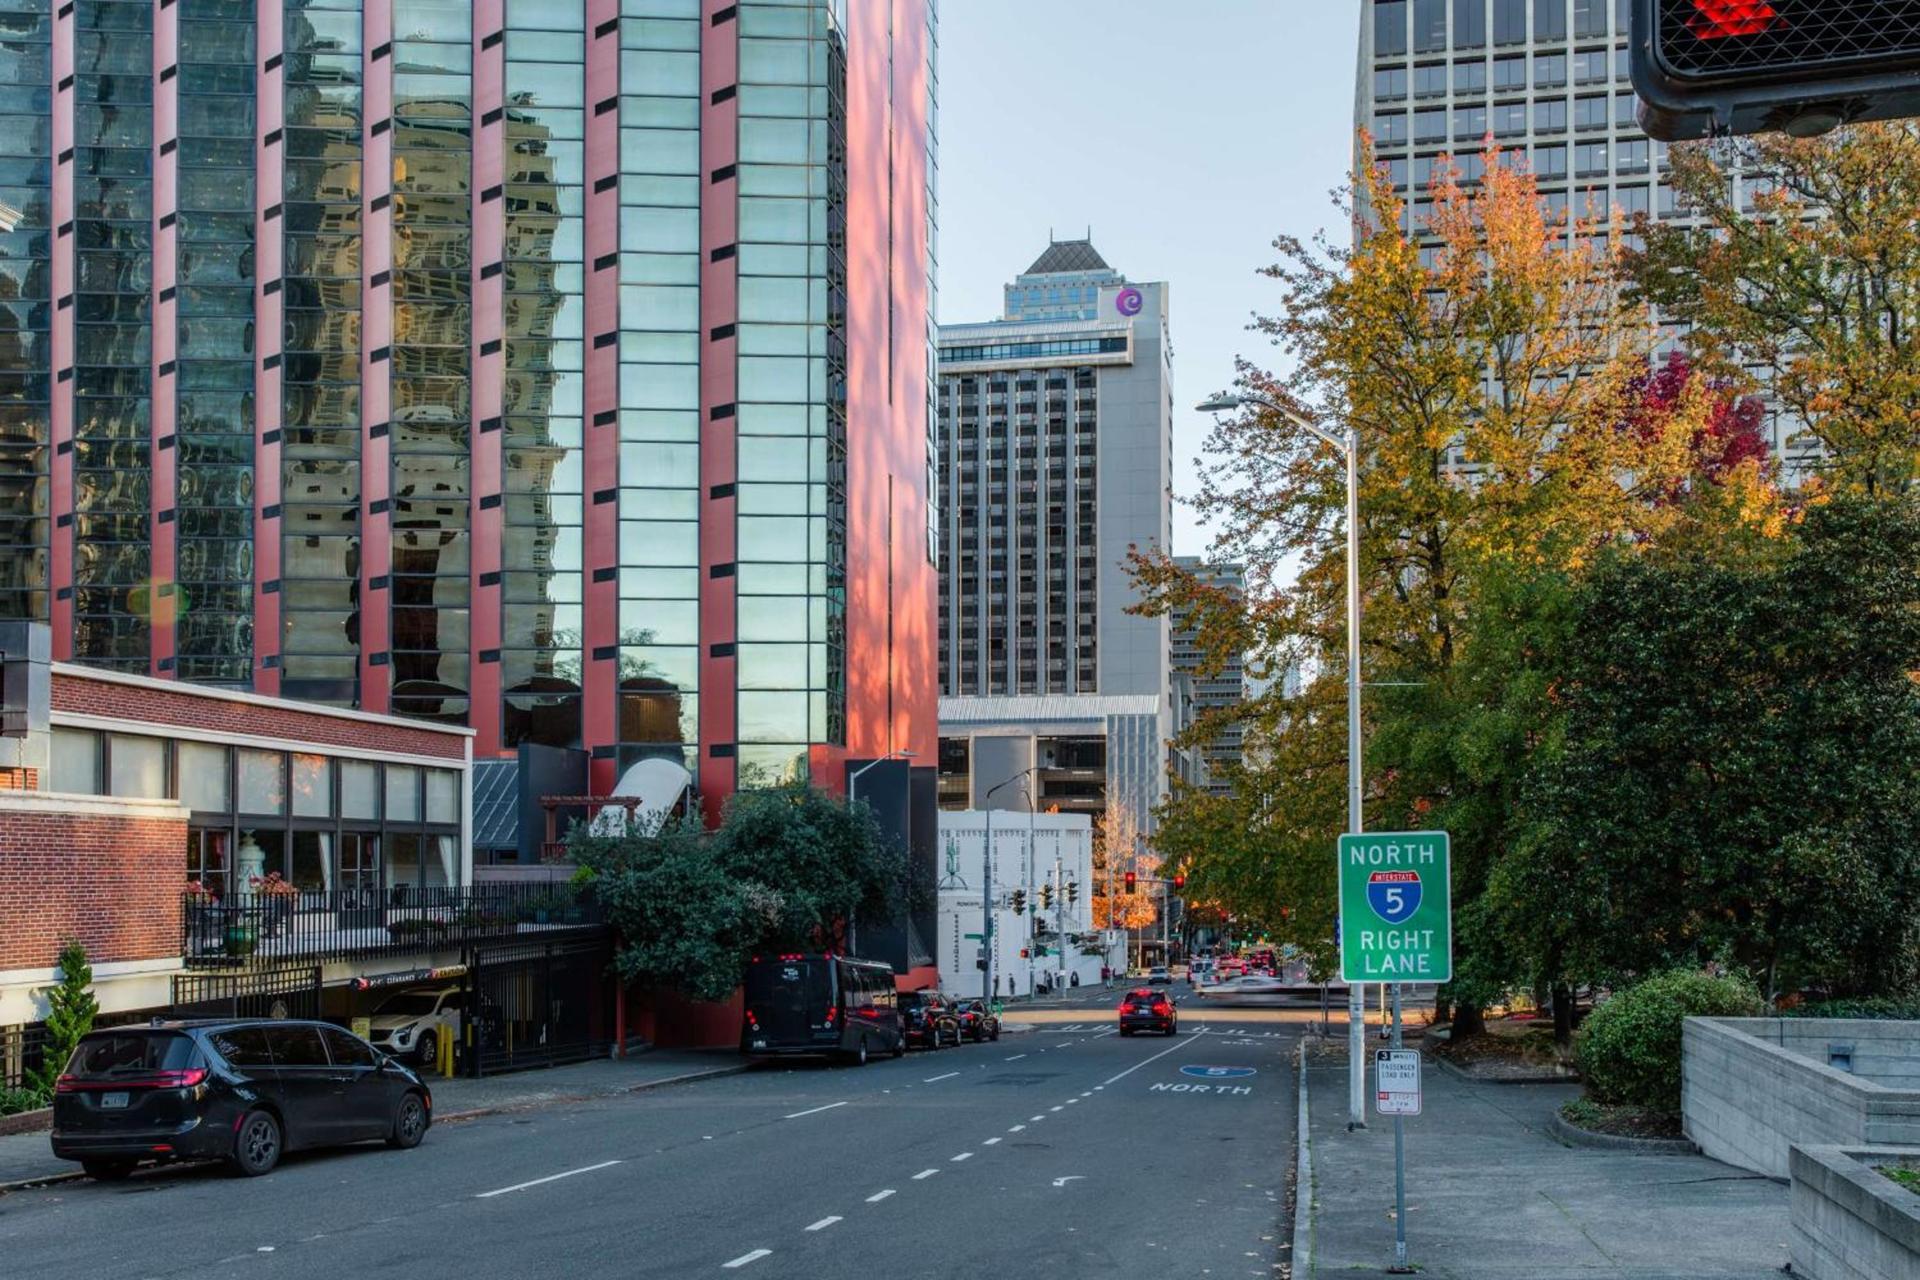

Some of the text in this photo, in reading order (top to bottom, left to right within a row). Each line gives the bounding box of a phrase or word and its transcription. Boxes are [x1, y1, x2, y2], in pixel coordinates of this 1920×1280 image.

[1351, 844, 1434, 865] NORTH
[1375, 873, 1413, 881] INTERSTATE
[1386, 888, 1404, 914] 5
[1361, 930, 1434, 950] RIGHT
[1365, 953, 1431, 973] LANE
[1381, 1051, 1388, 1060] 3
[1206, 1067, 1229, 1075] 5
[1381, 1063, 1415, 1071] PASSENGER
[1149, 1082, 1252, 1095] NORTH
